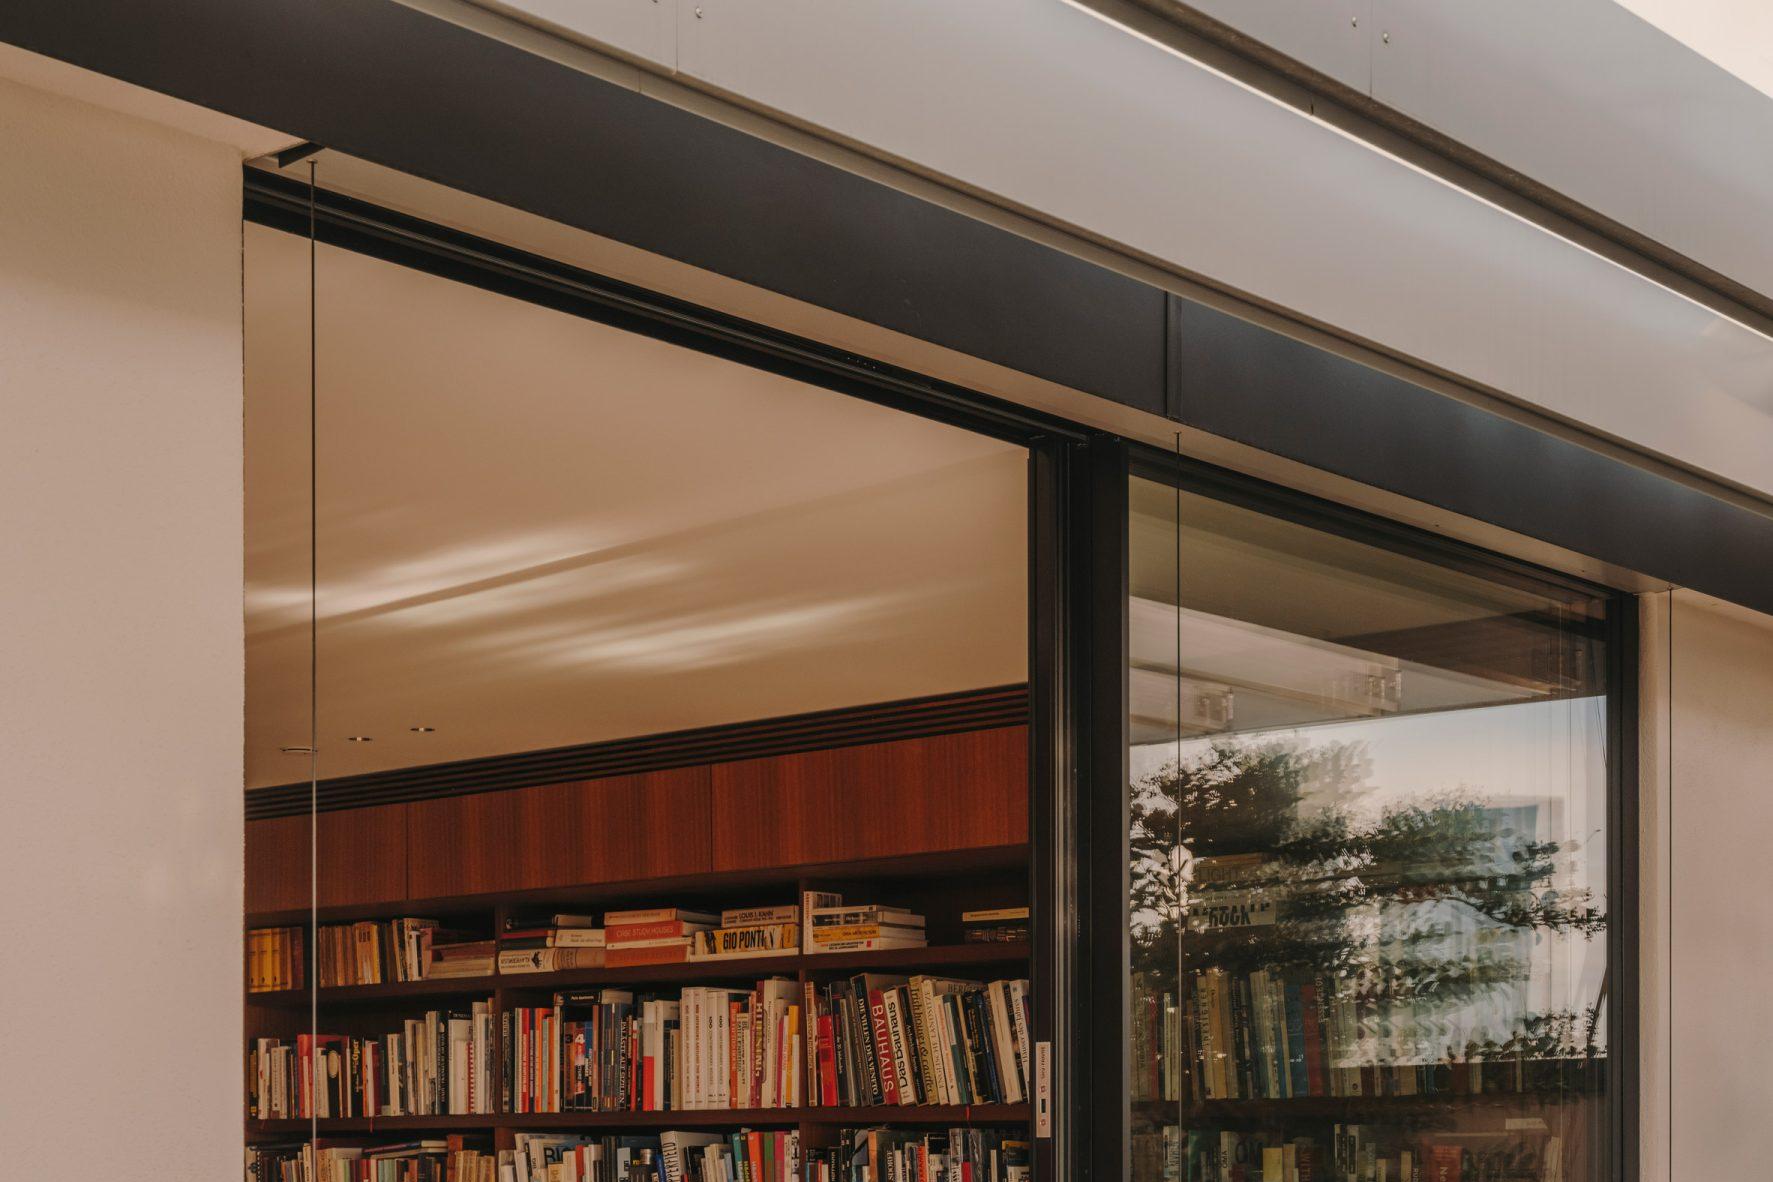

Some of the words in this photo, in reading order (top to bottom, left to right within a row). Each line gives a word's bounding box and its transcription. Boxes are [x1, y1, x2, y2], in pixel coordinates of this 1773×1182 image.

[723, 932, 737, 950] GIO
[738, 929, 766, 949] PONTI
[911, 988, 923, 1012] Irish
[754, 1002, 763, 1077] HOUSING
[859, 1011, 871, 1043] VILLEN
[887, 1002, 903, 1060] Bauhaus
[912, 1012, 926, 1047] houses
[863, 1044, 874, 1060] DES
[871, 1004, 894, 1093] BAUHAUS
[866, 1061, 879, 1096] VENETO
[895, 1061, 908, 1088] Das
[920, 1060, 933, 1094] castles
